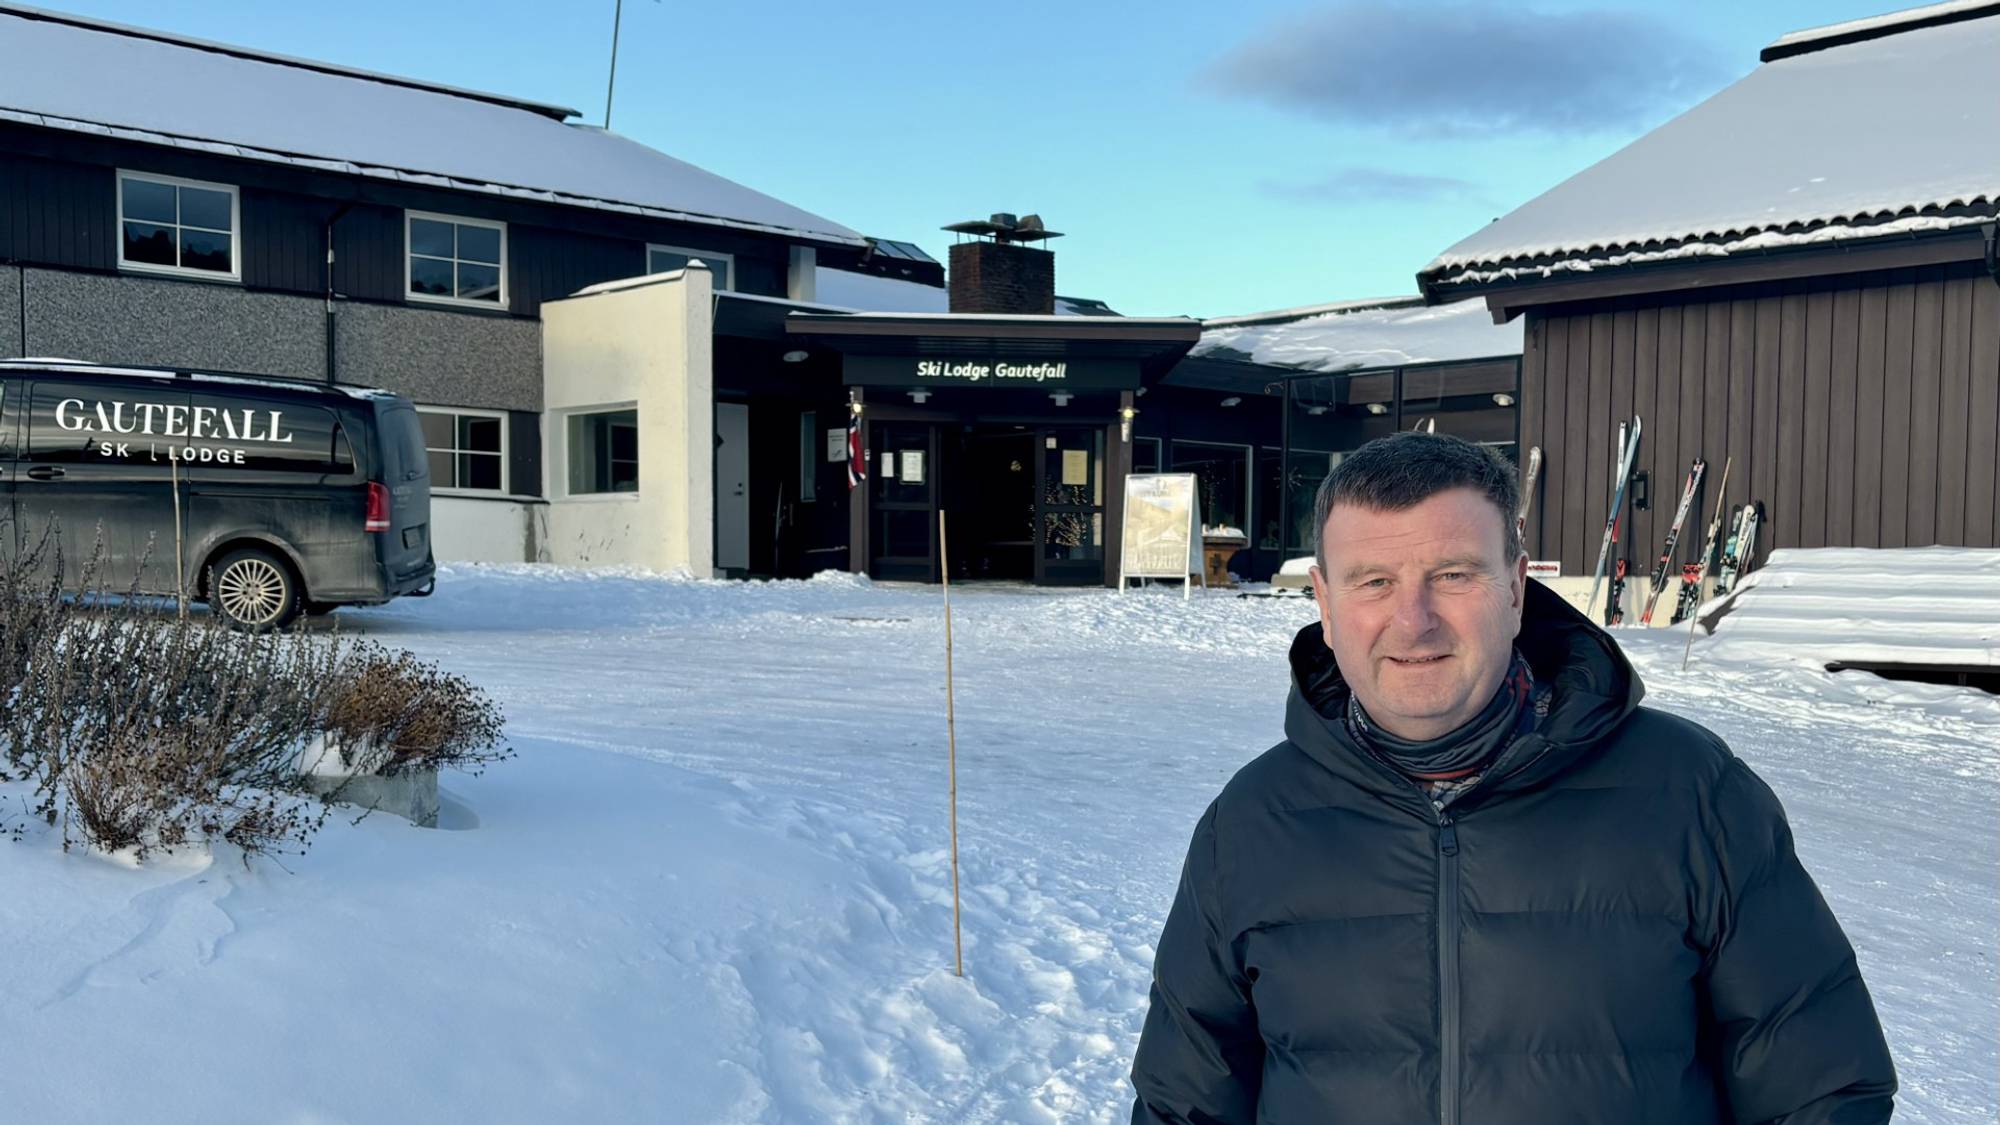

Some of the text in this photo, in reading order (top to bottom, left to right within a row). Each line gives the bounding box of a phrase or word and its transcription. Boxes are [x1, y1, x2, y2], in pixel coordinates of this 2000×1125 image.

[917, 361, 1067, 382] Ski Lodge Gautefall
[55, 398, 293, 443] GAUTEFALL
[168, 445, 246, 464] LODGE
